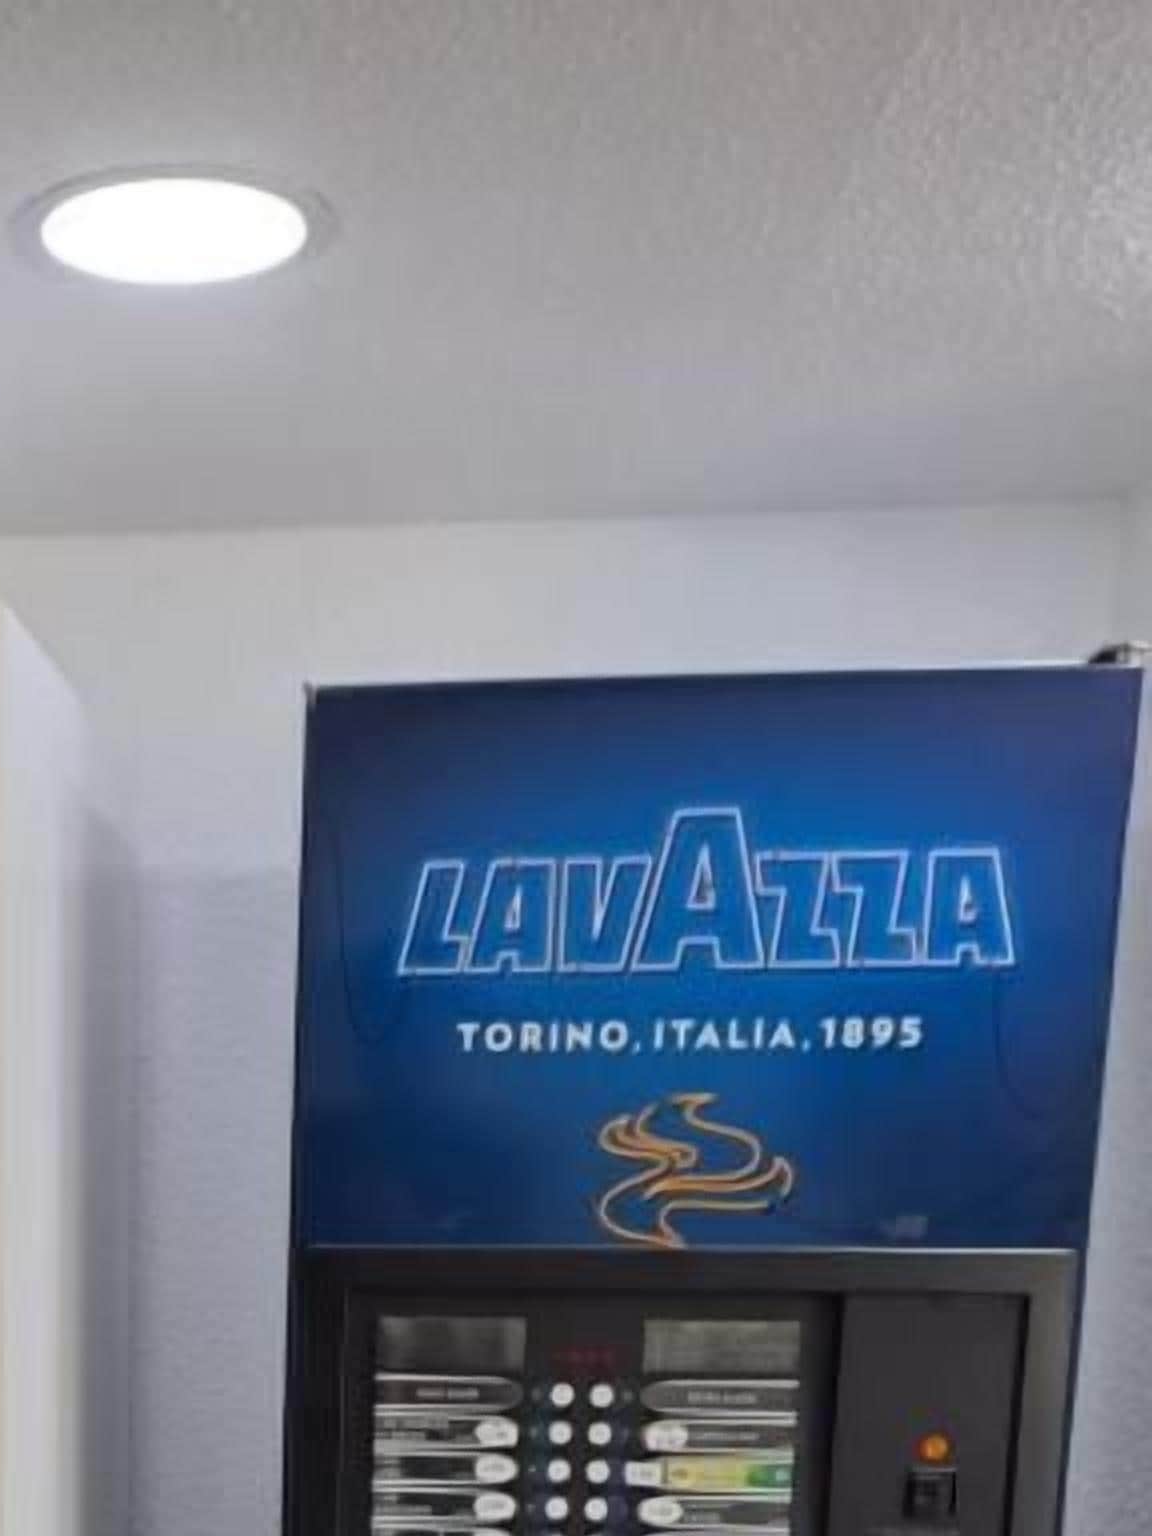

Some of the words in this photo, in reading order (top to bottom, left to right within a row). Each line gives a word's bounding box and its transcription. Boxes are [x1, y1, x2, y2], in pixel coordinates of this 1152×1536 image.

[396, 806, 1017, 977] LAVAZZA
[455, 1020, 642, 1056] TORINO,
[653, 1016, 811, 1053] ITALIA,
[820, 1015, 925, 1050] 1895
